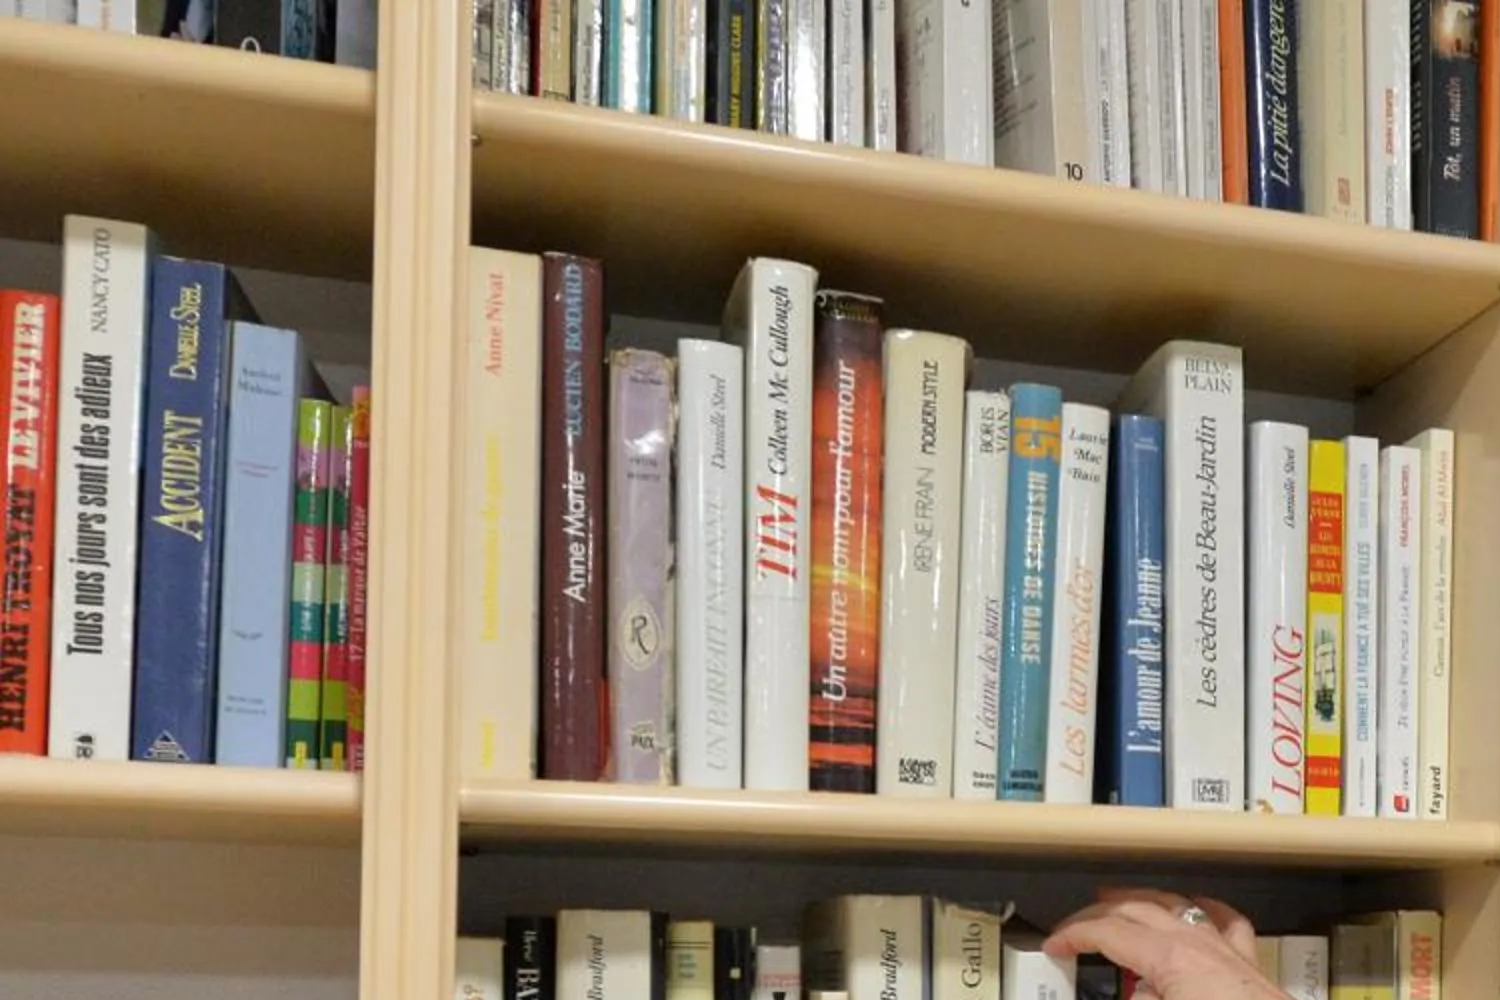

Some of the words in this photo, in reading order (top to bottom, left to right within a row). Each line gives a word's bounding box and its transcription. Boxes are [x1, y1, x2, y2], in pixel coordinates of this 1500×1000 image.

[1267, 92, 1293, 157] pitié
[1449, 76, 1461, 123] matin
[1450, 126, 1461, 148] un
[1065, 163, 1083, 181] 10
[1270, 152, 1290, 187] La
[90, 228, 111, 271] CATO
[91, 274, 109, 333] NANCY
[563, 262, 584, 351] BODARD
[769, 285, 790, 367] Cullough
[12, 302, 45, 424] VIVIER
[73, 353, 112, 419] adieux
[768, 376, 788, 401] Mc
[920, 358, 939, 396] STYLE
[568, 359, 584, 438] LUCIEN
[834, 358, 857, 457] l'amour
[919, 396, 938, 455] MODERN
[8, 433, 38, 470] LE
[73, 424, 110, 459] des
[768, 406, 788, 478] Colleen
[73, 461, 109, 508] sont
[152, 410, 202, 541] ACCIDENT
[561, 470, 587, 539] Marie
[834, 463, 858, 526] pour
[1200, 415, 1218, 552] Beau-Jardin
[0, 484, 36, 613] TROYAT
[71, 512, 111, 567] jours
[757, 485, 798, 579] TIM
[1024, 470, 1049, 570] HISTOIRES
[72, 570, 106, 607] nos
[561, 542, 587, 603] Anne
[833, 531, 852, 585] nom
[1023, 577, 1043, 599] DE
[1198, 553, 1217, 583] de
[828, 590, 849, 660] autre
[980, 596, 1000, 642] jours
[1129, 557, 1163, 633] Jeanne
[1199, 586, 1217, 663] cèdres
[66, 612, 103, 656] Tous
[976, 643, 998, 669] des
[1021, 603, 1042, 666] DANSE
[1128, 637, 1161, 663] de
[0, 621, 30, 732] HENRI
[823, 665, 848, 703] Un
[1197, 669, 1217, 708] Les
[973, 675, 998, 752] L'écume
[1128, 664, 1162, 752] L'amour
[1272, 625, 1305, 798] LOVING
[1430, 766, 1443, 814] fayard
[587, 934, 607, 1000] Bradford
[963, 922, 983, 988] Gallo
